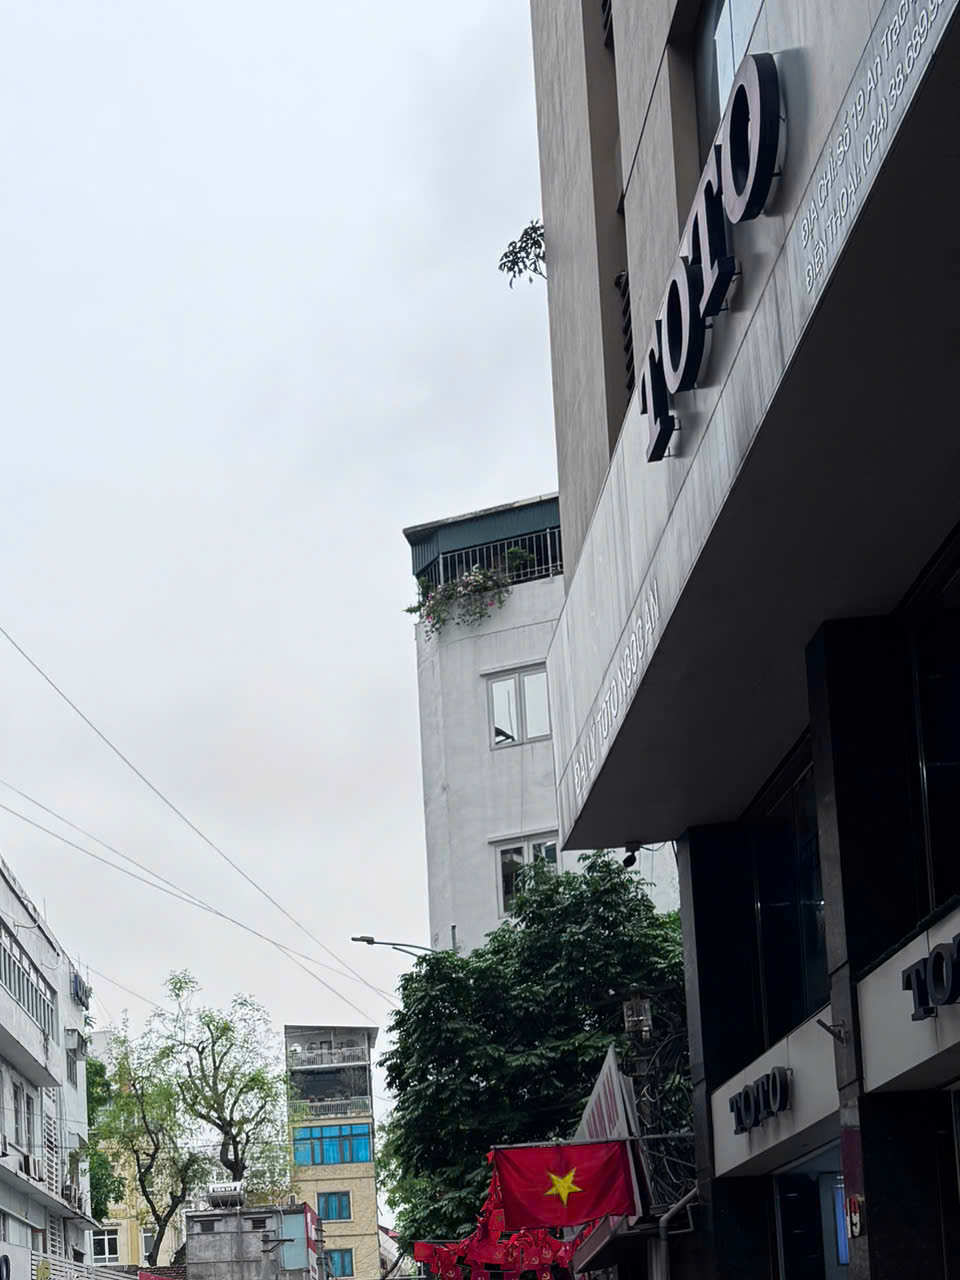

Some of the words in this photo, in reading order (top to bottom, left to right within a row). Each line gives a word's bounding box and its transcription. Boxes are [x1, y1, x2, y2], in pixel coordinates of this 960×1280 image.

[888, 0, 944, 112] 38.689.9
[851, 88, 866, 131] 19
[640, 53, 779, 462] TOTO
[597, 690, 620, 745] TOTO
[729, 1066, 789, 1135] TOTO
